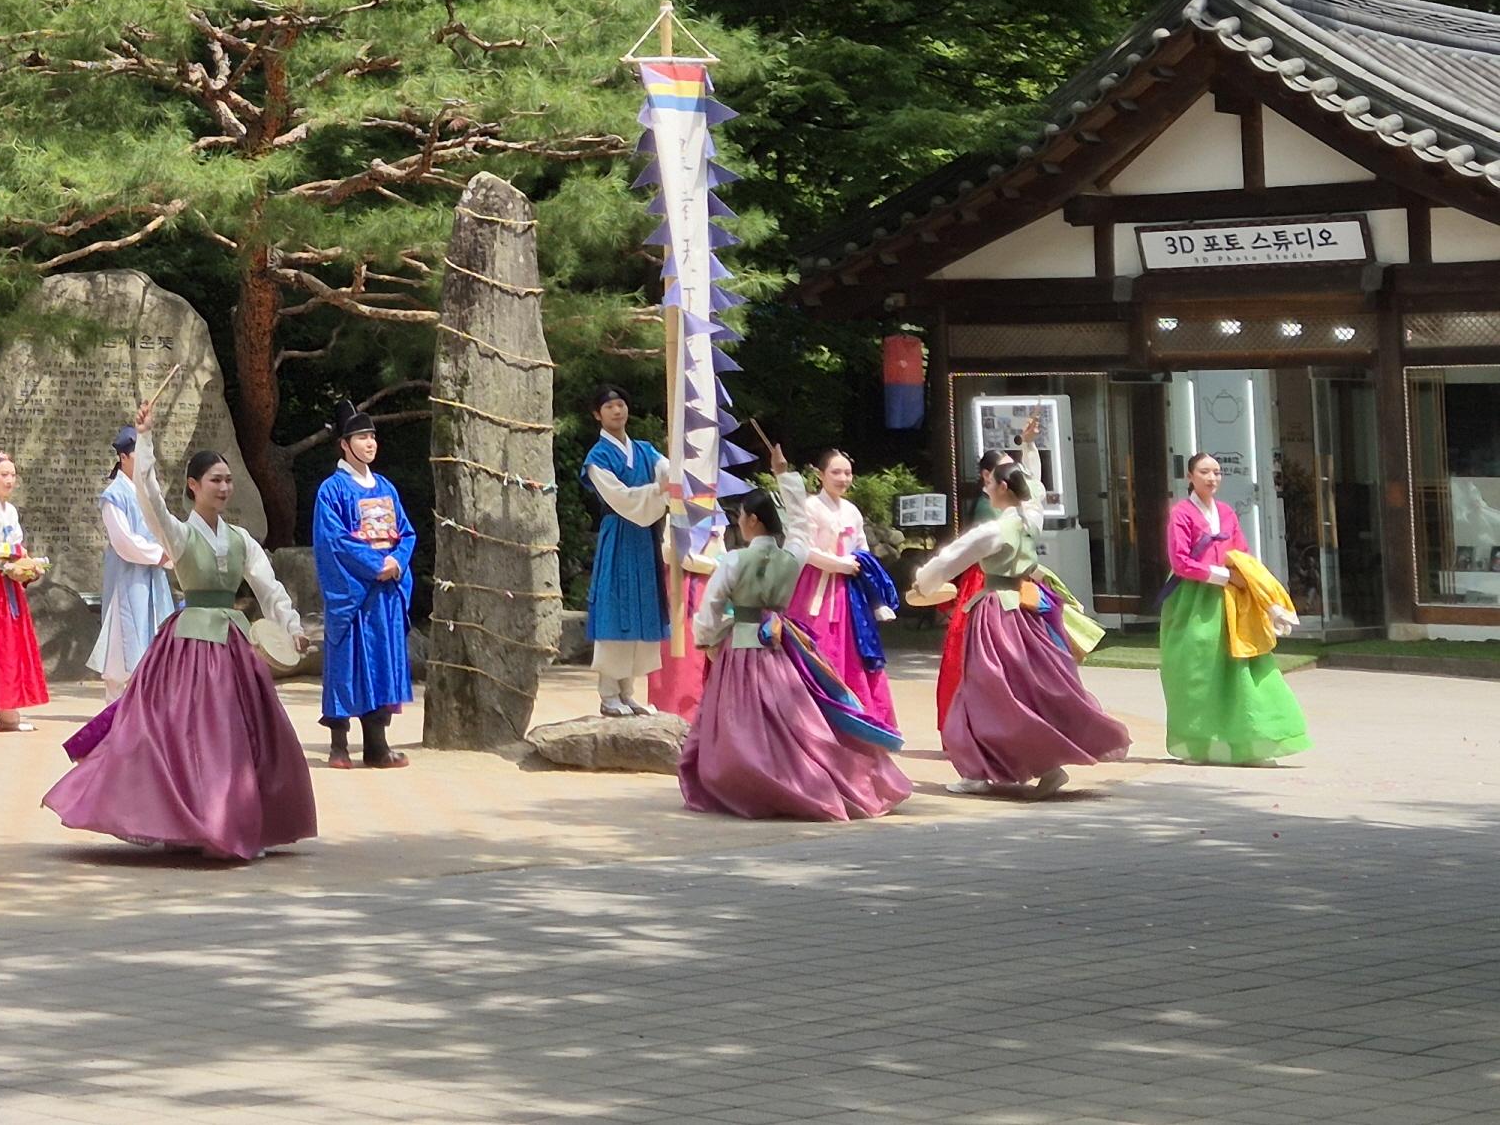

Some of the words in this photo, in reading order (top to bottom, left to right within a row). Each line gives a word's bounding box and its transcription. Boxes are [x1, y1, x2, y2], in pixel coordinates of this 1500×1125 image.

[1165, 235, 1195, 255] 3D
[1203, 233, 1245, 253] 포토
[1251, 228, 1338, 251] 스튜디오
[1218, 254, 1257, 263] Photo
[1266, 252, 1313, 261] Studio
